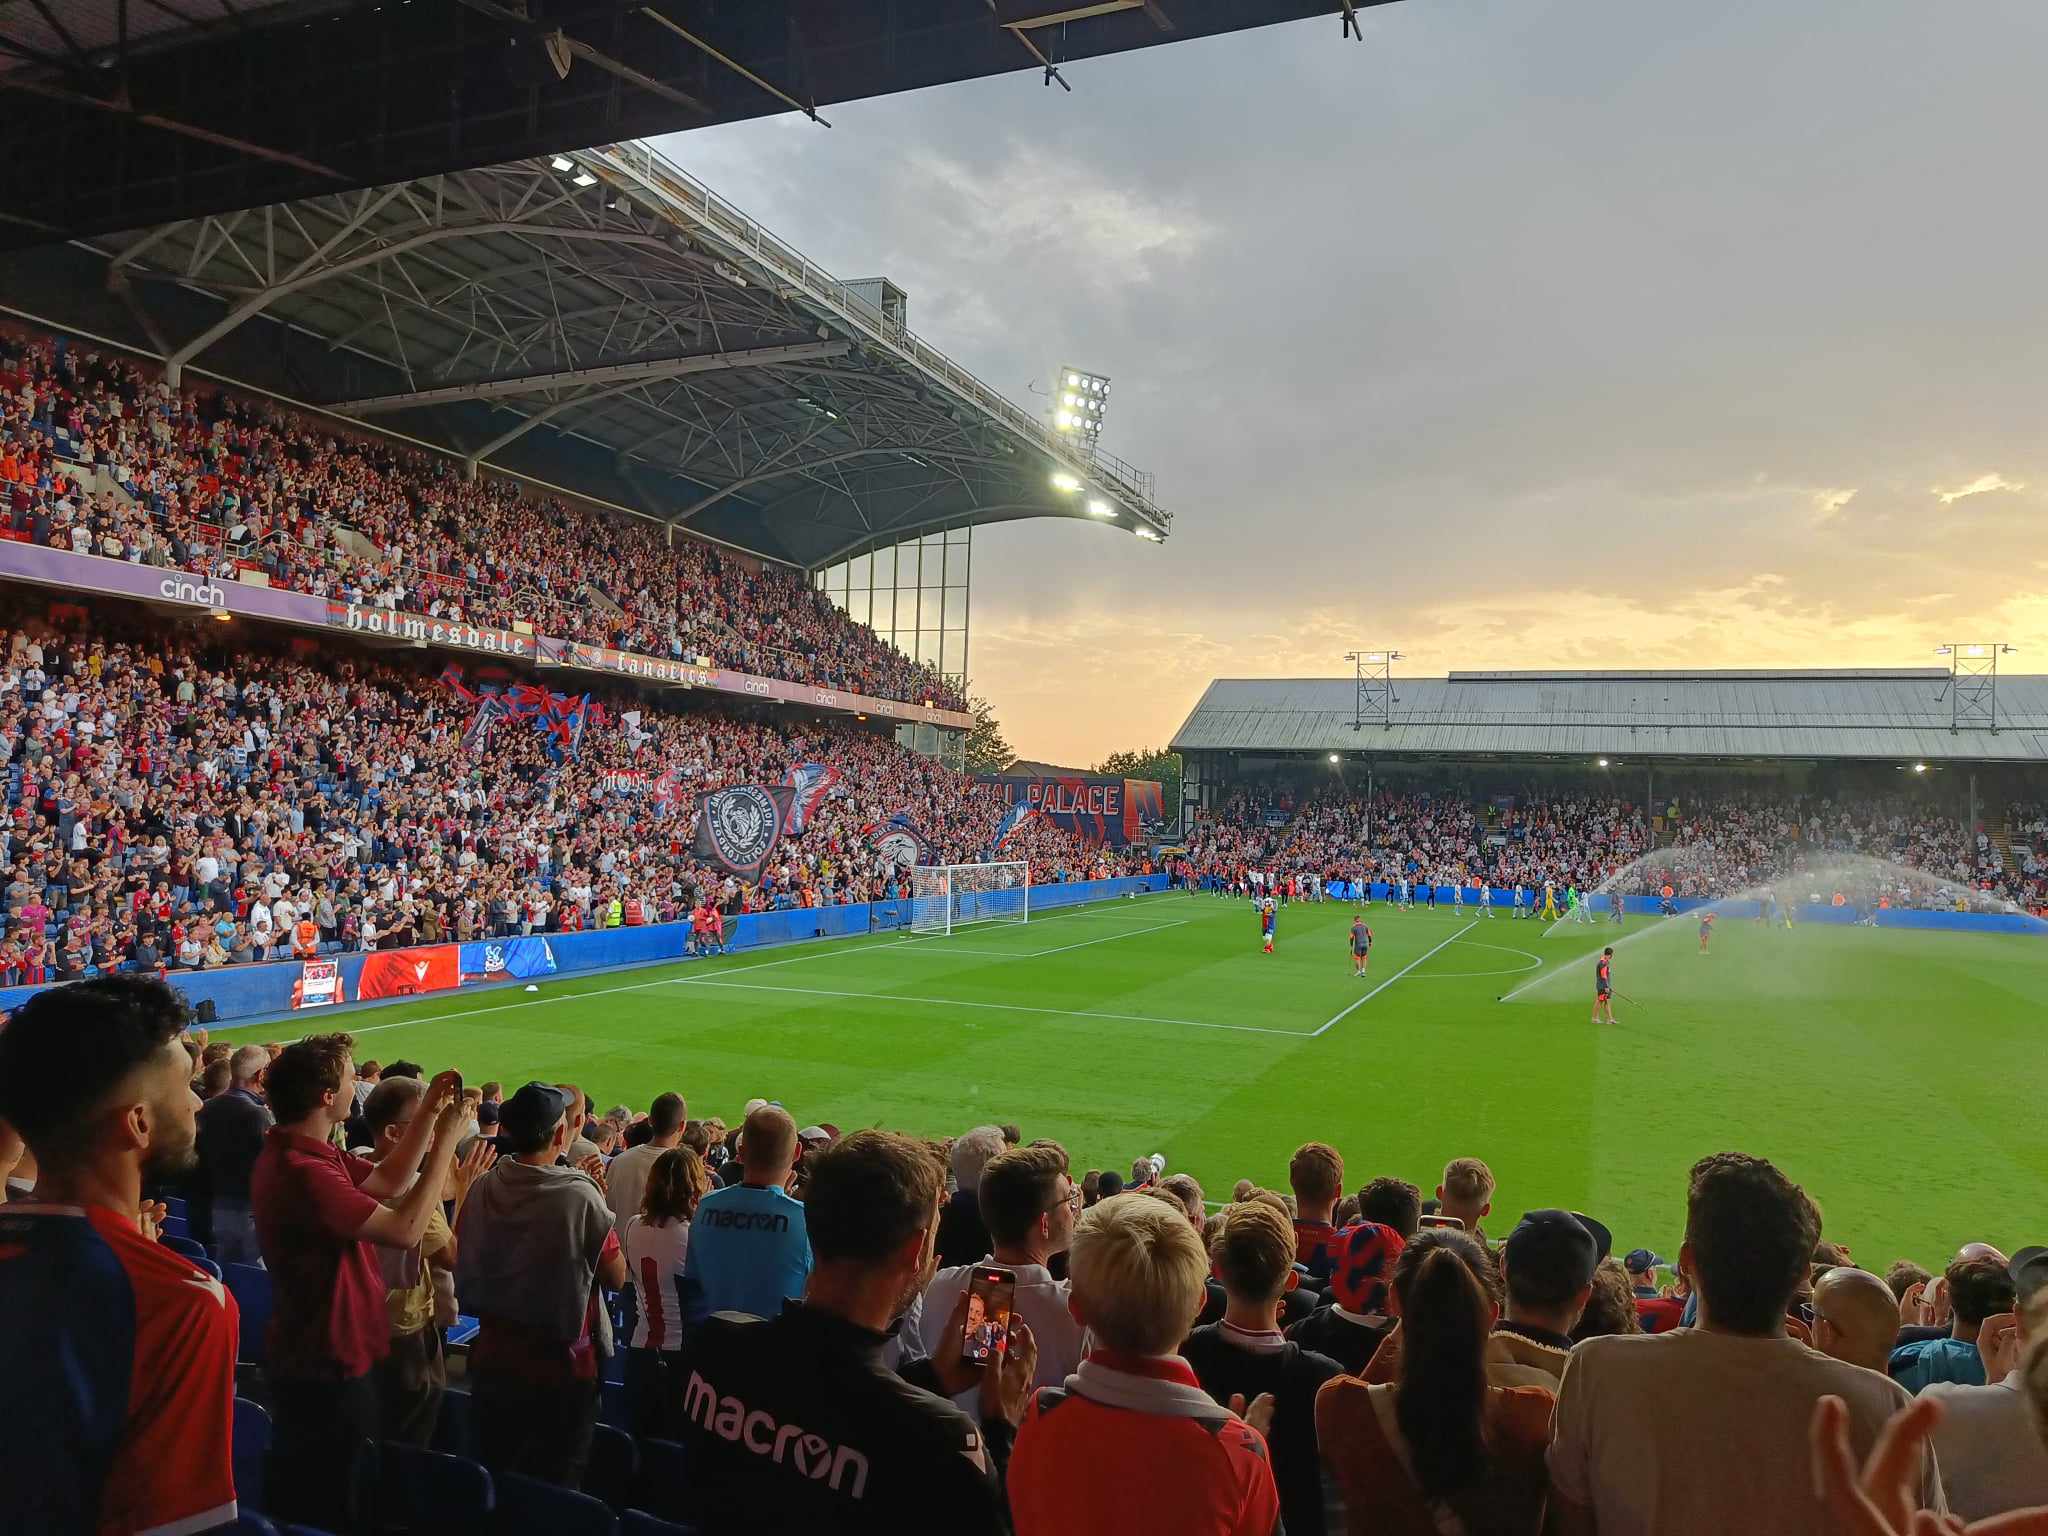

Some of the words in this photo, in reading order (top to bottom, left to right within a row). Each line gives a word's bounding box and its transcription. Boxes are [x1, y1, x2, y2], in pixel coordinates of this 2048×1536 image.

[160, 574, 225, 606] cinch
[346, 603, 525, 654] holmesdale
[617, 652, 708, 685] fanatics
[744, 679, 770, 695] cinch
[816, 690, 837, 705] cinch
[1027, 784, 1120, 815] PALACE
[701, 1207, 790, 1233] macron
[683, 1369, 870, 1500] macron
